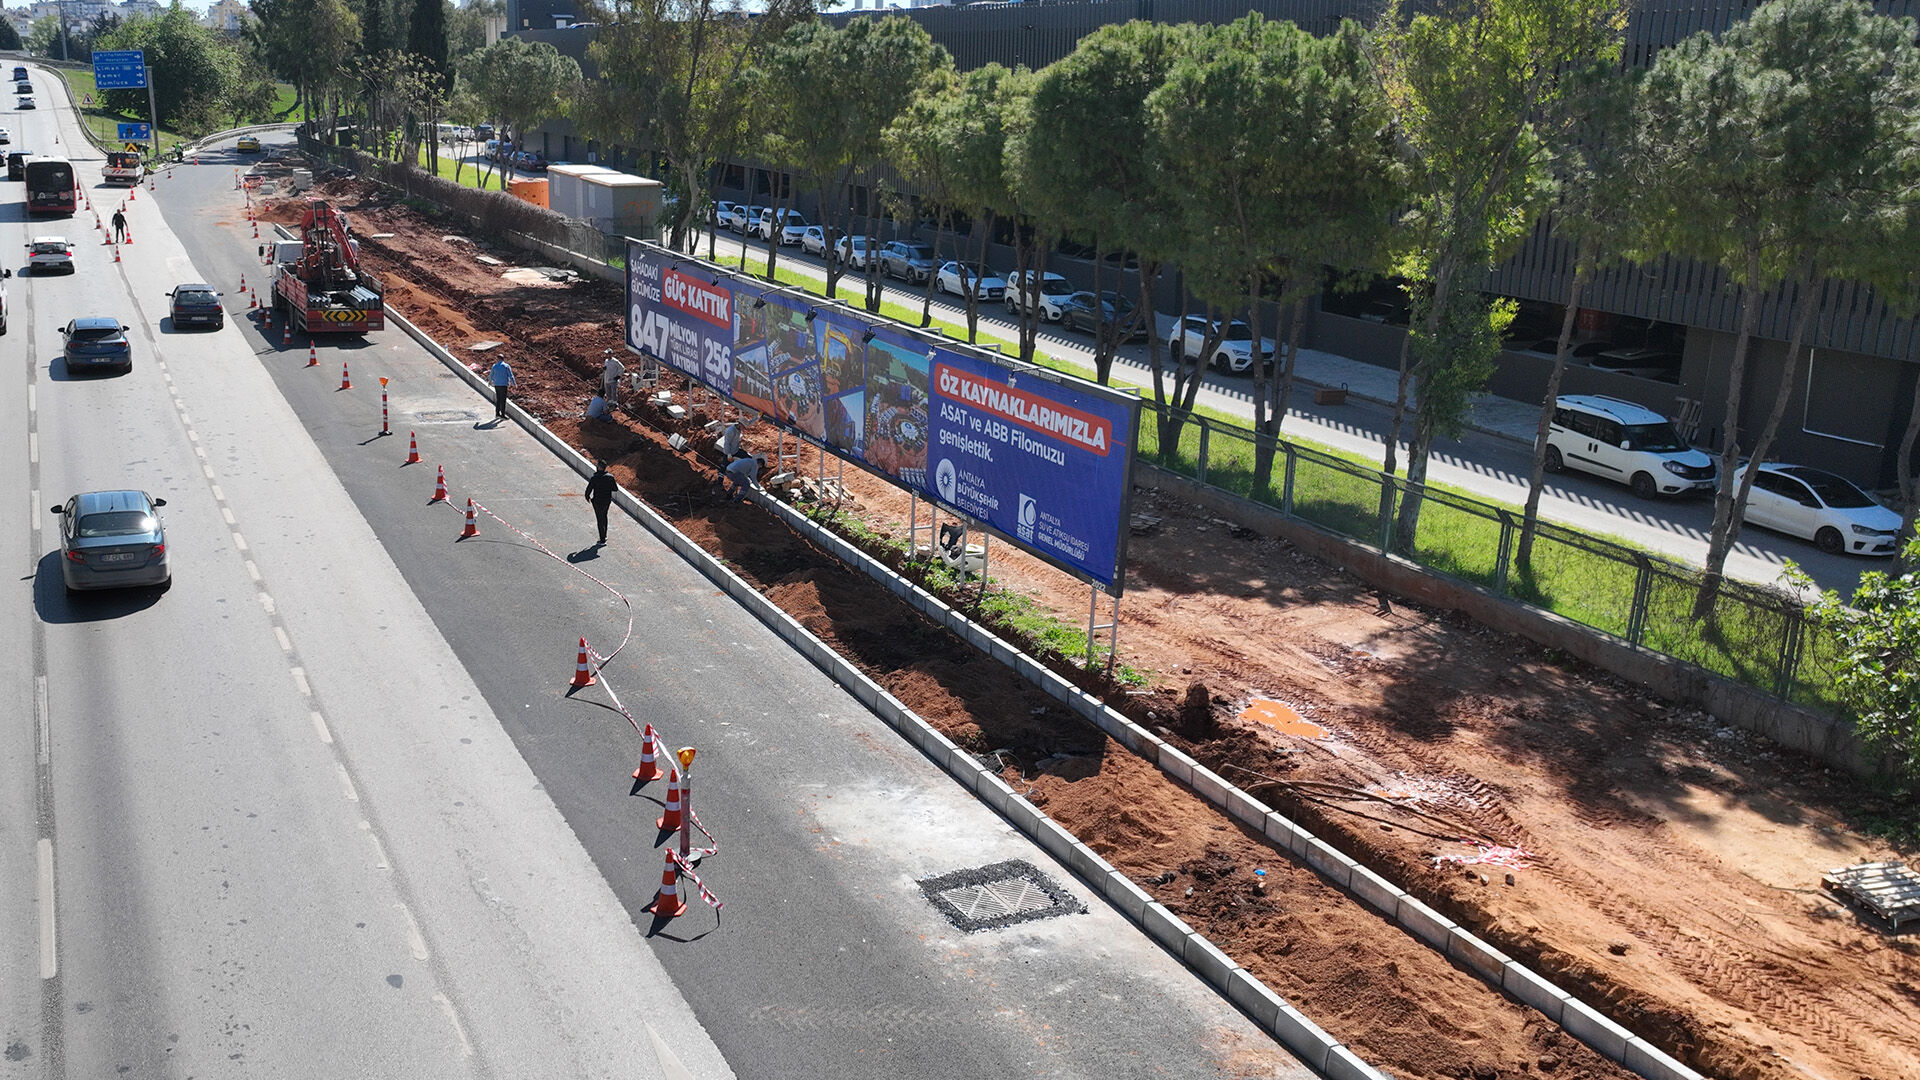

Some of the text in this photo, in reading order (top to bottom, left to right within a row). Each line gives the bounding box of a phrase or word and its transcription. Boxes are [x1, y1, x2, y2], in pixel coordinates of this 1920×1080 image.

[630, 259, 658, 281] SAHADAKİ
[631, 281, 660, 303] GÜCÜMÜZE
[664, 275, 729, 322] GÜÇ KATTIK
[631, 304, 670, 360] 847
[670, 320, 698, 347] MİLYON
[671, 352, 700, 376] YATIRIM
[704, 338, 731, 380] 256
[940, 368, 1106, 450] ÖZ KAYNAKLARIMIZLA
[939, 428, 994, 463] genişlettik.
[940, 403, 1065, 466] ASAT ve ABB Filomuzu
[958, 469, 985, 489] ANTALYA
[957, 483, 998, 511] BÜYÜKŞEHİR
[957, 498, 989, 520] BELEDİYESİ
[1017, 524, 1033, 539] asat
[1040, 511, 1060, 527] ANTALYA
[1038, 532, 1054, 547] GENEL
